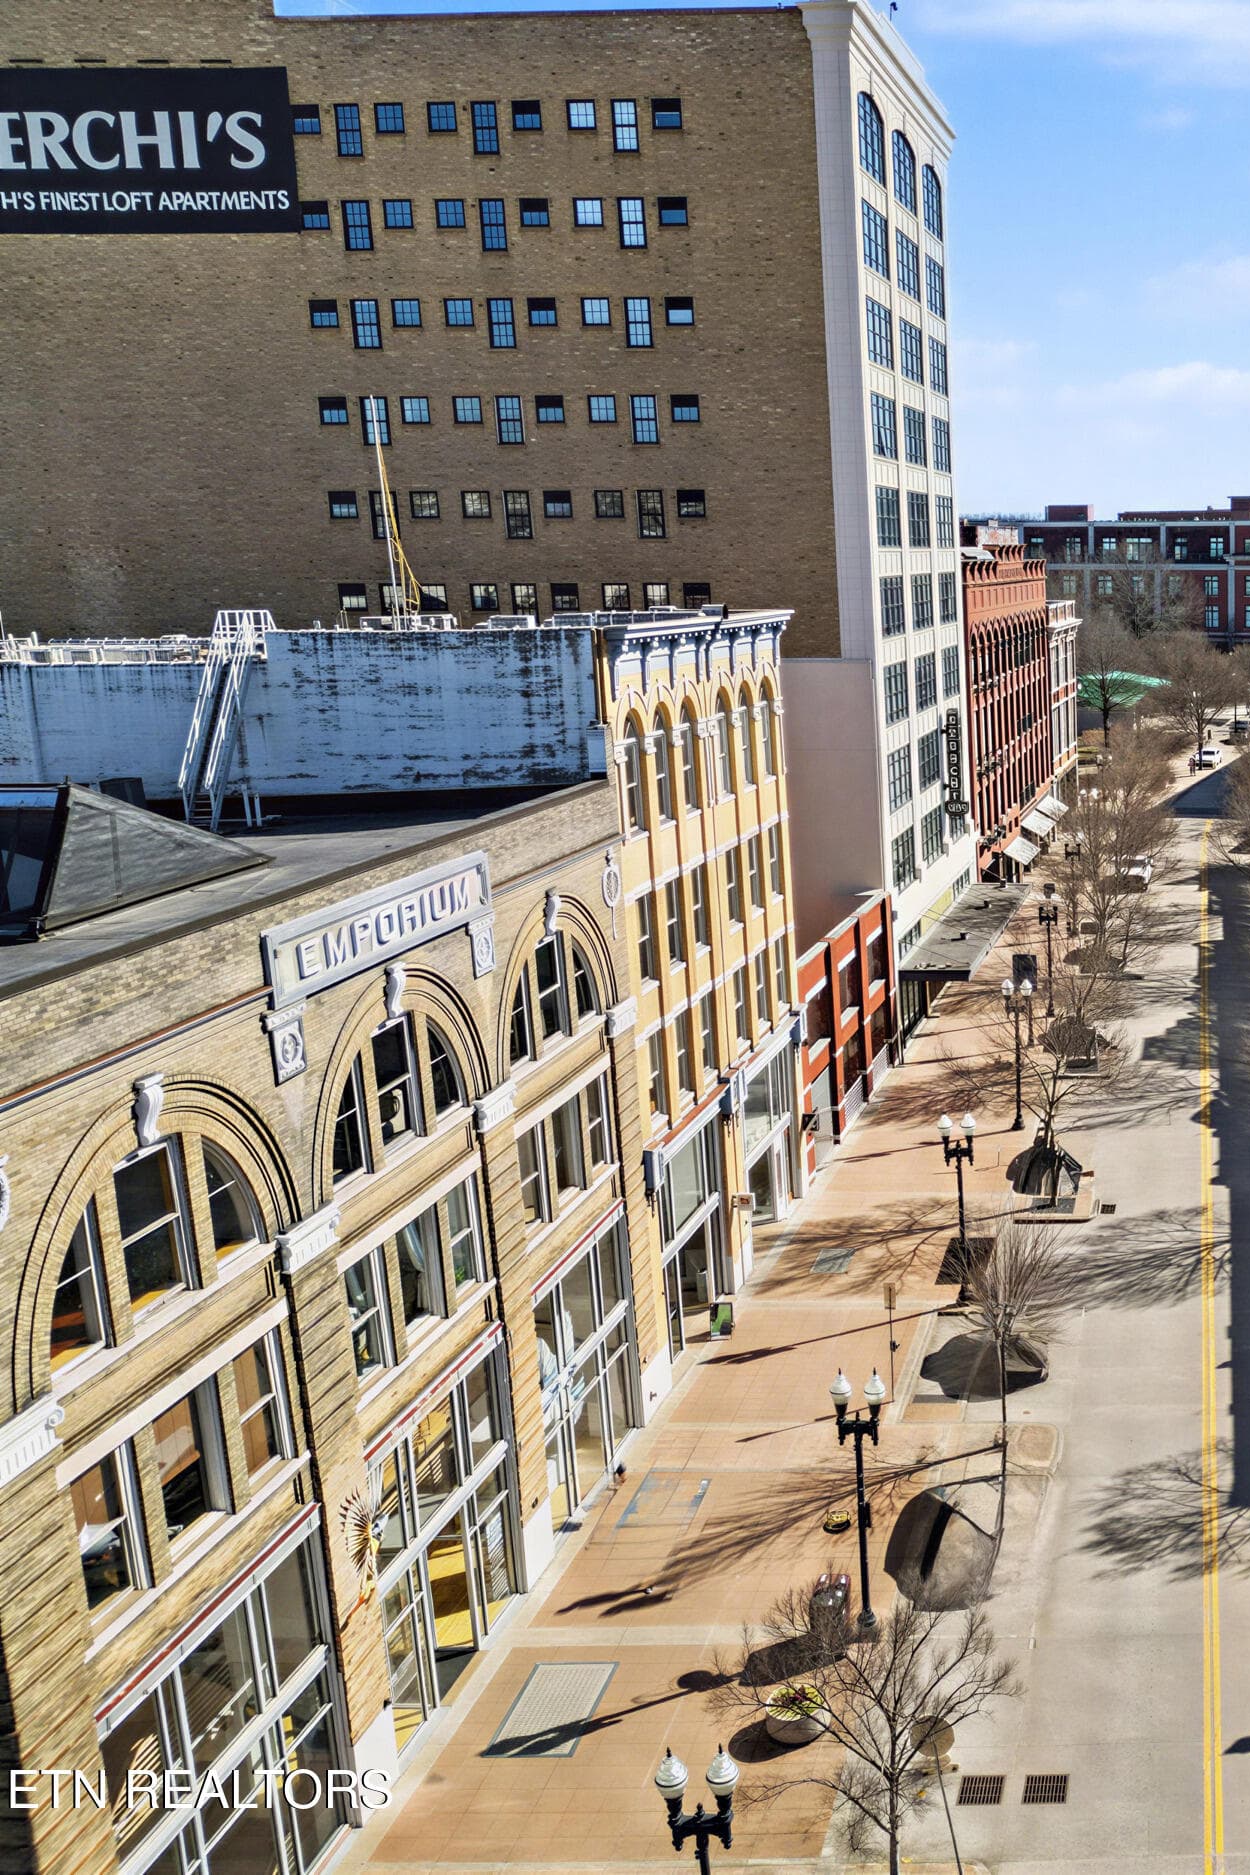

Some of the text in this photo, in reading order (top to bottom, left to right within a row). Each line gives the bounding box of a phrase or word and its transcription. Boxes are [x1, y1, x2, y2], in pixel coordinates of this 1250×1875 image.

[0, 110, 266, 171] ERCHI'S
[0, 190, 290, 212] H'S FINEST LOFT APARTMENTS
[296, 876, 470, 979] EMPORIUM
